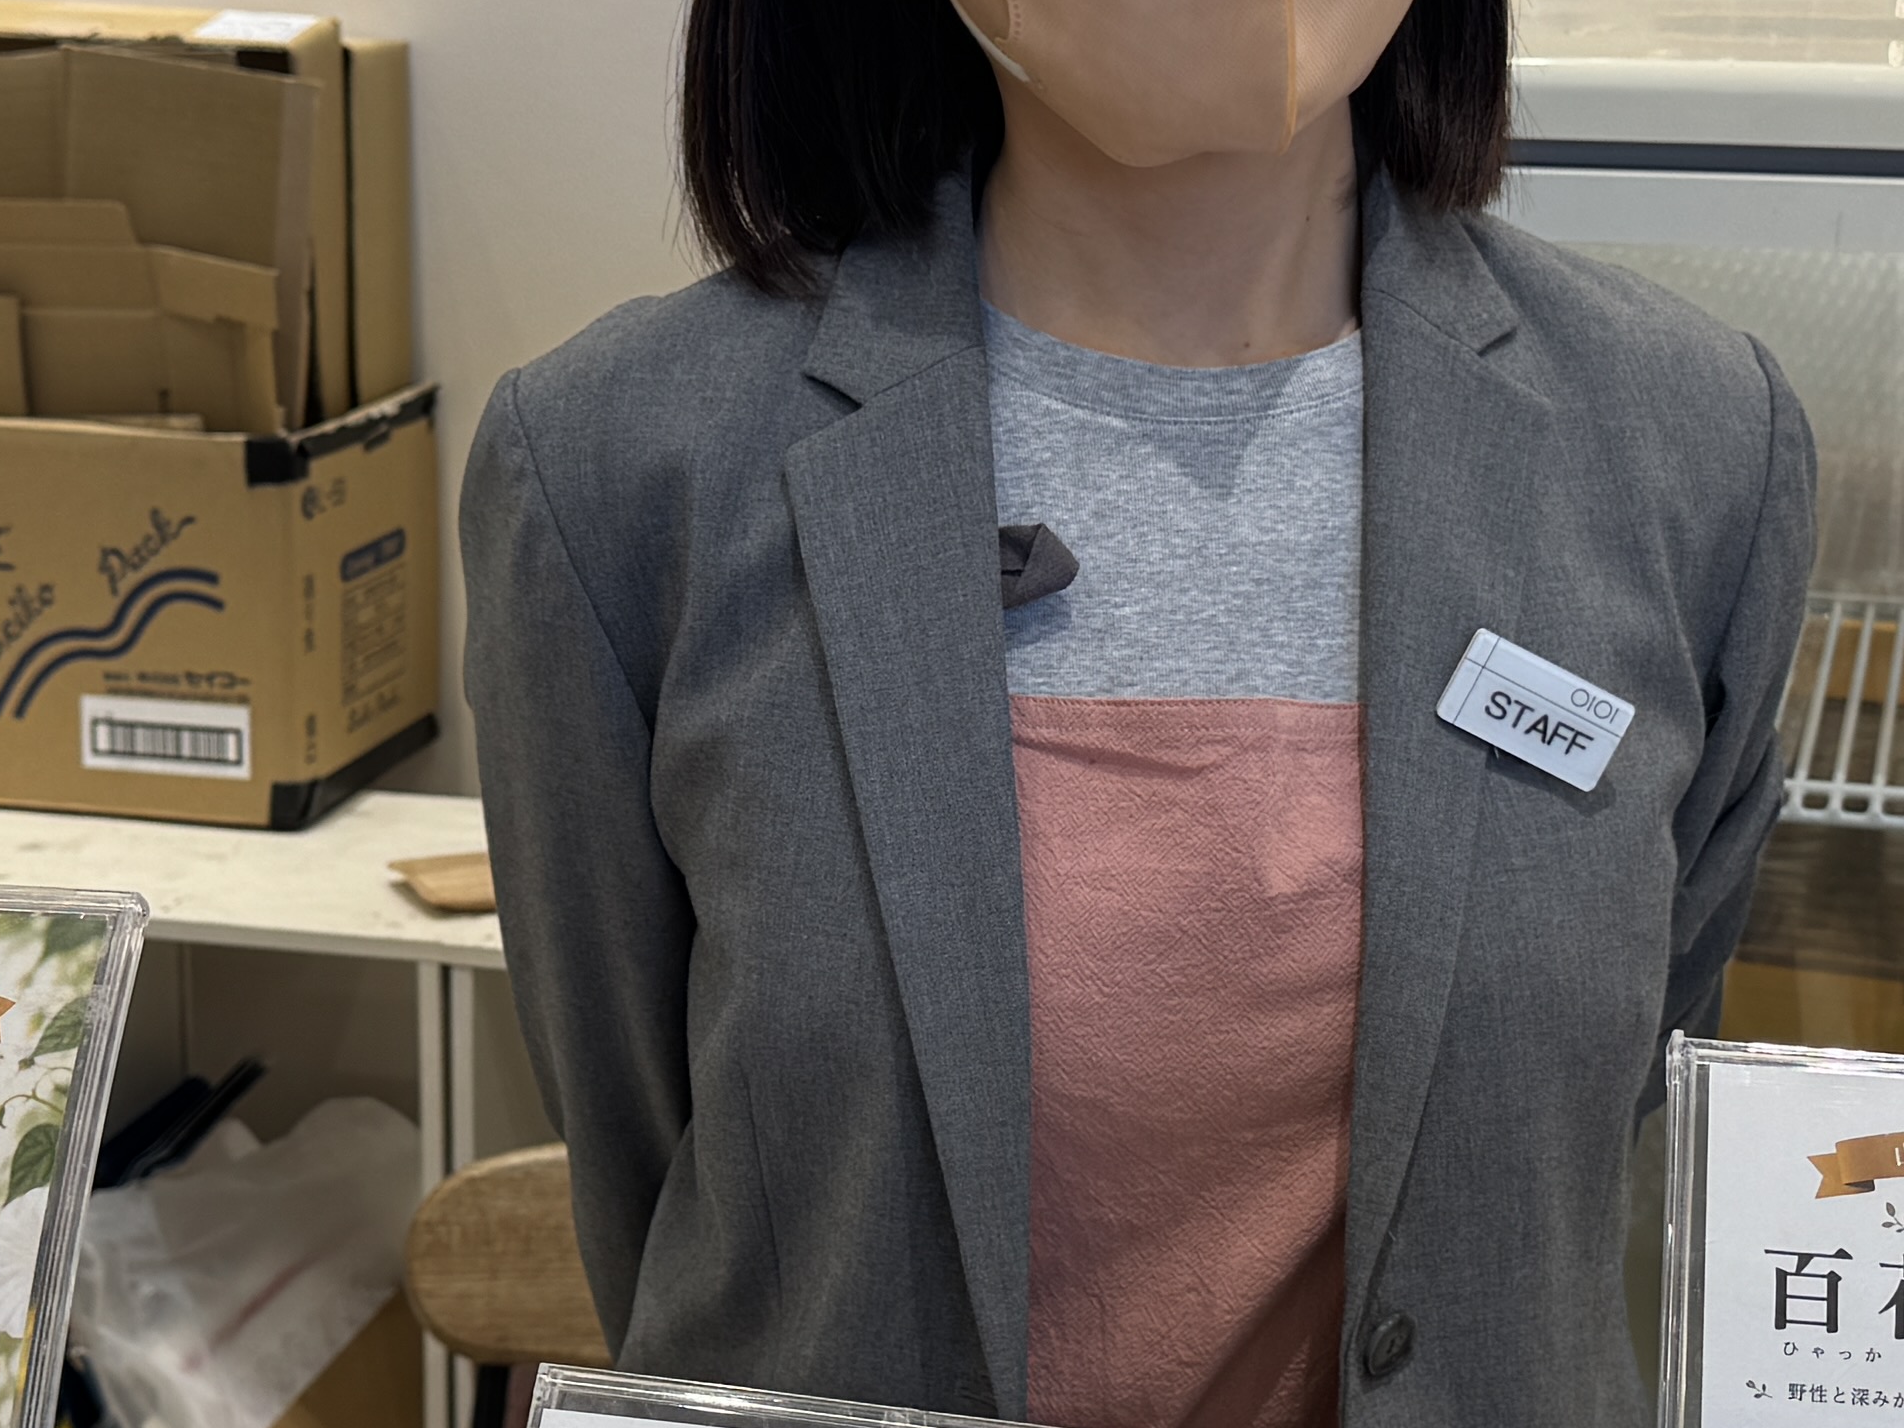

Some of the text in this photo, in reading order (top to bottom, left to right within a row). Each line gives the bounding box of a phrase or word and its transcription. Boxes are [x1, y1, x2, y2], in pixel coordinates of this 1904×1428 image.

[1484, 691, 1594, 755] STAFF
[1782, 1340, 1884, 1363] ひゃっか
